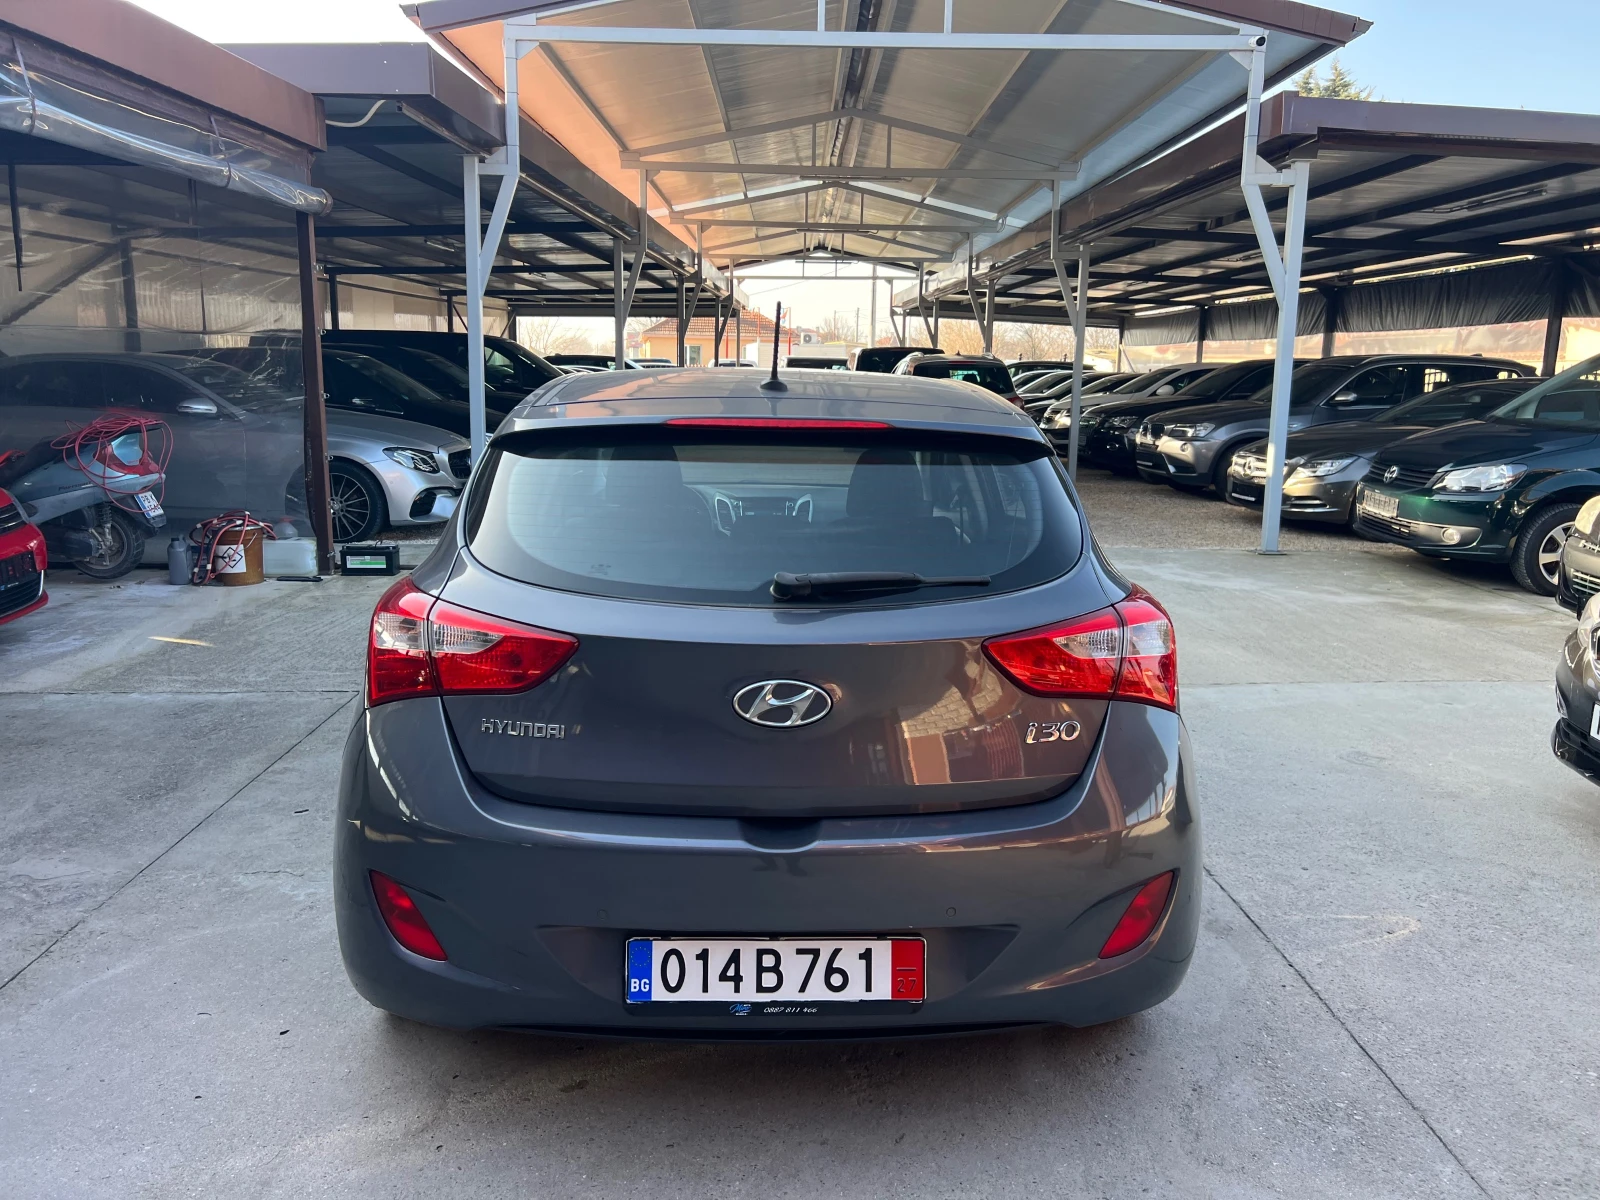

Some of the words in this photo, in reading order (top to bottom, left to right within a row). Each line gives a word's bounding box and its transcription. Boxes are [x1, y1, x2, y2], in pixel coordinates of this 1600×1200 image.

[481, 718, 565, 739] HYUNDAI
[1025, 720, 1081, 744] i30
[660, 947, 874, 994] 014B761
[630, 979, 650, 992] BG
[897, 977, 917, 993] 27
